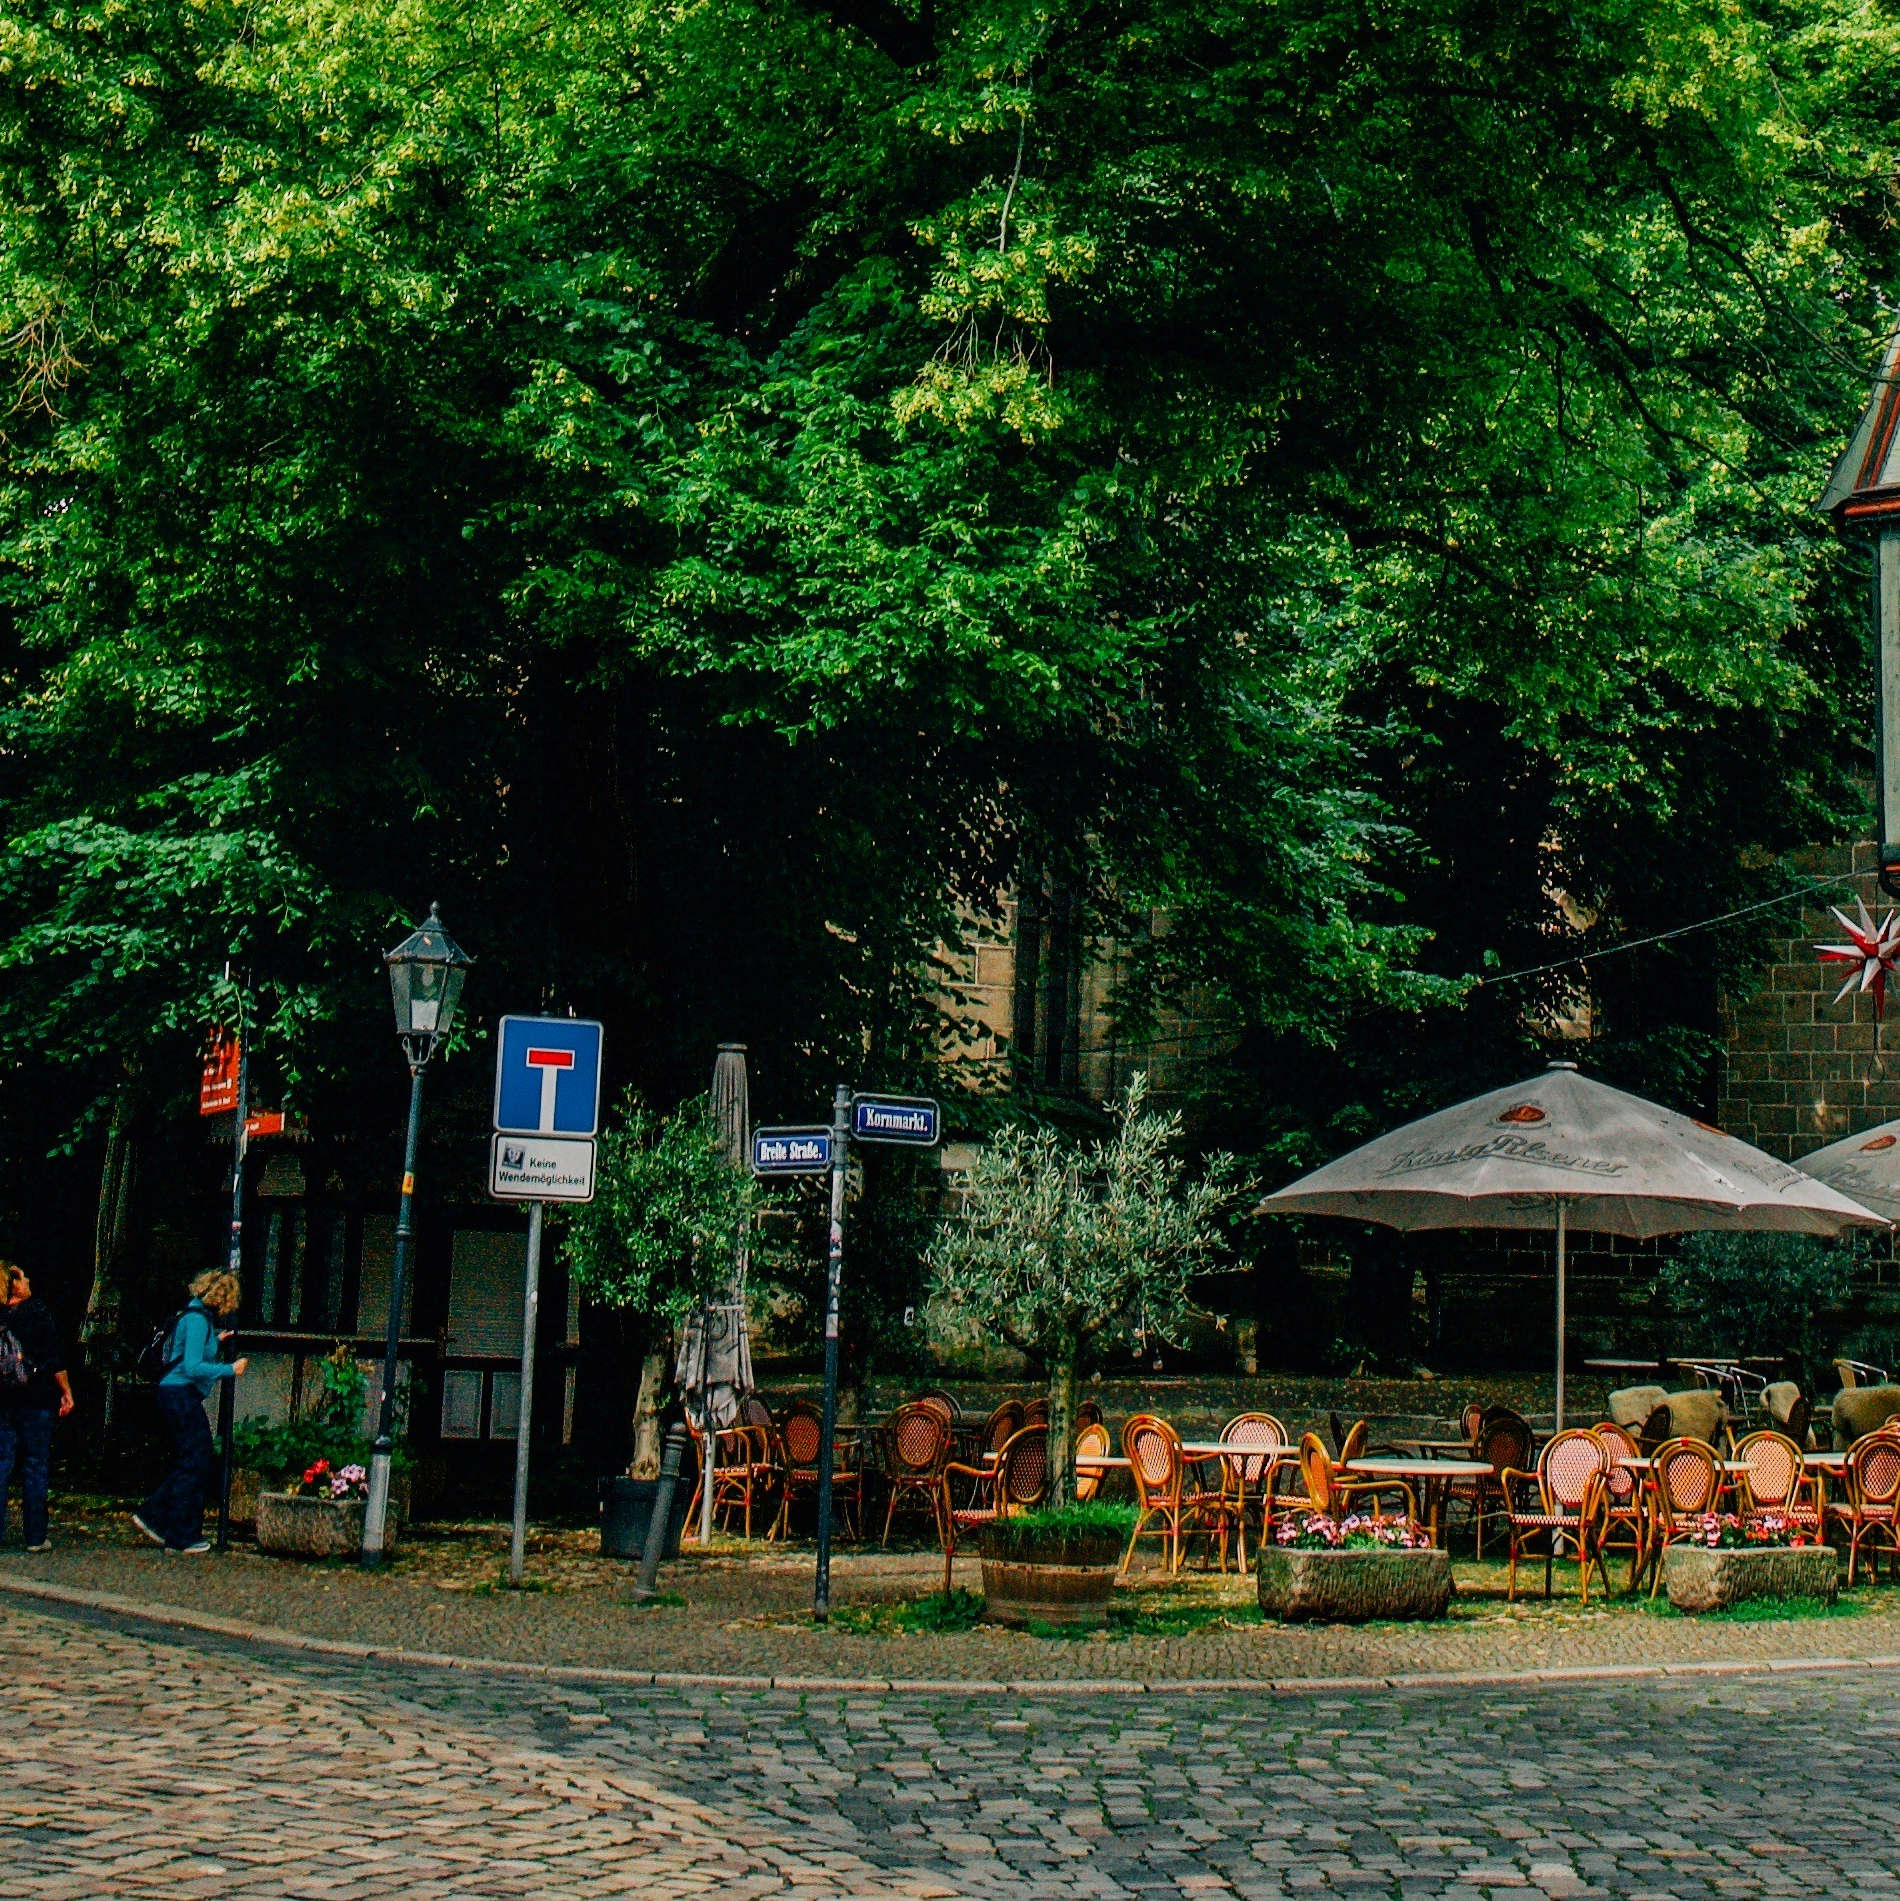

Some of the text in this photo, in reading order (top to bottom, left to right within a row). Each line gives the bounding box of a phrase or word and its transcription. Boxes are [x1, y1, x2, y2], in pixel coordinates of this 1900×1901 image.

[865, 1107, 928, 1131] Kornmarkt.
[760, 1140, 823, 1161] Breite Straße.
[1373, 1142, 1490, 1175] König
[529, 1157, 557, 1169] Keine
[499, 1170, 585, 1187] Wendemöglichkeit
